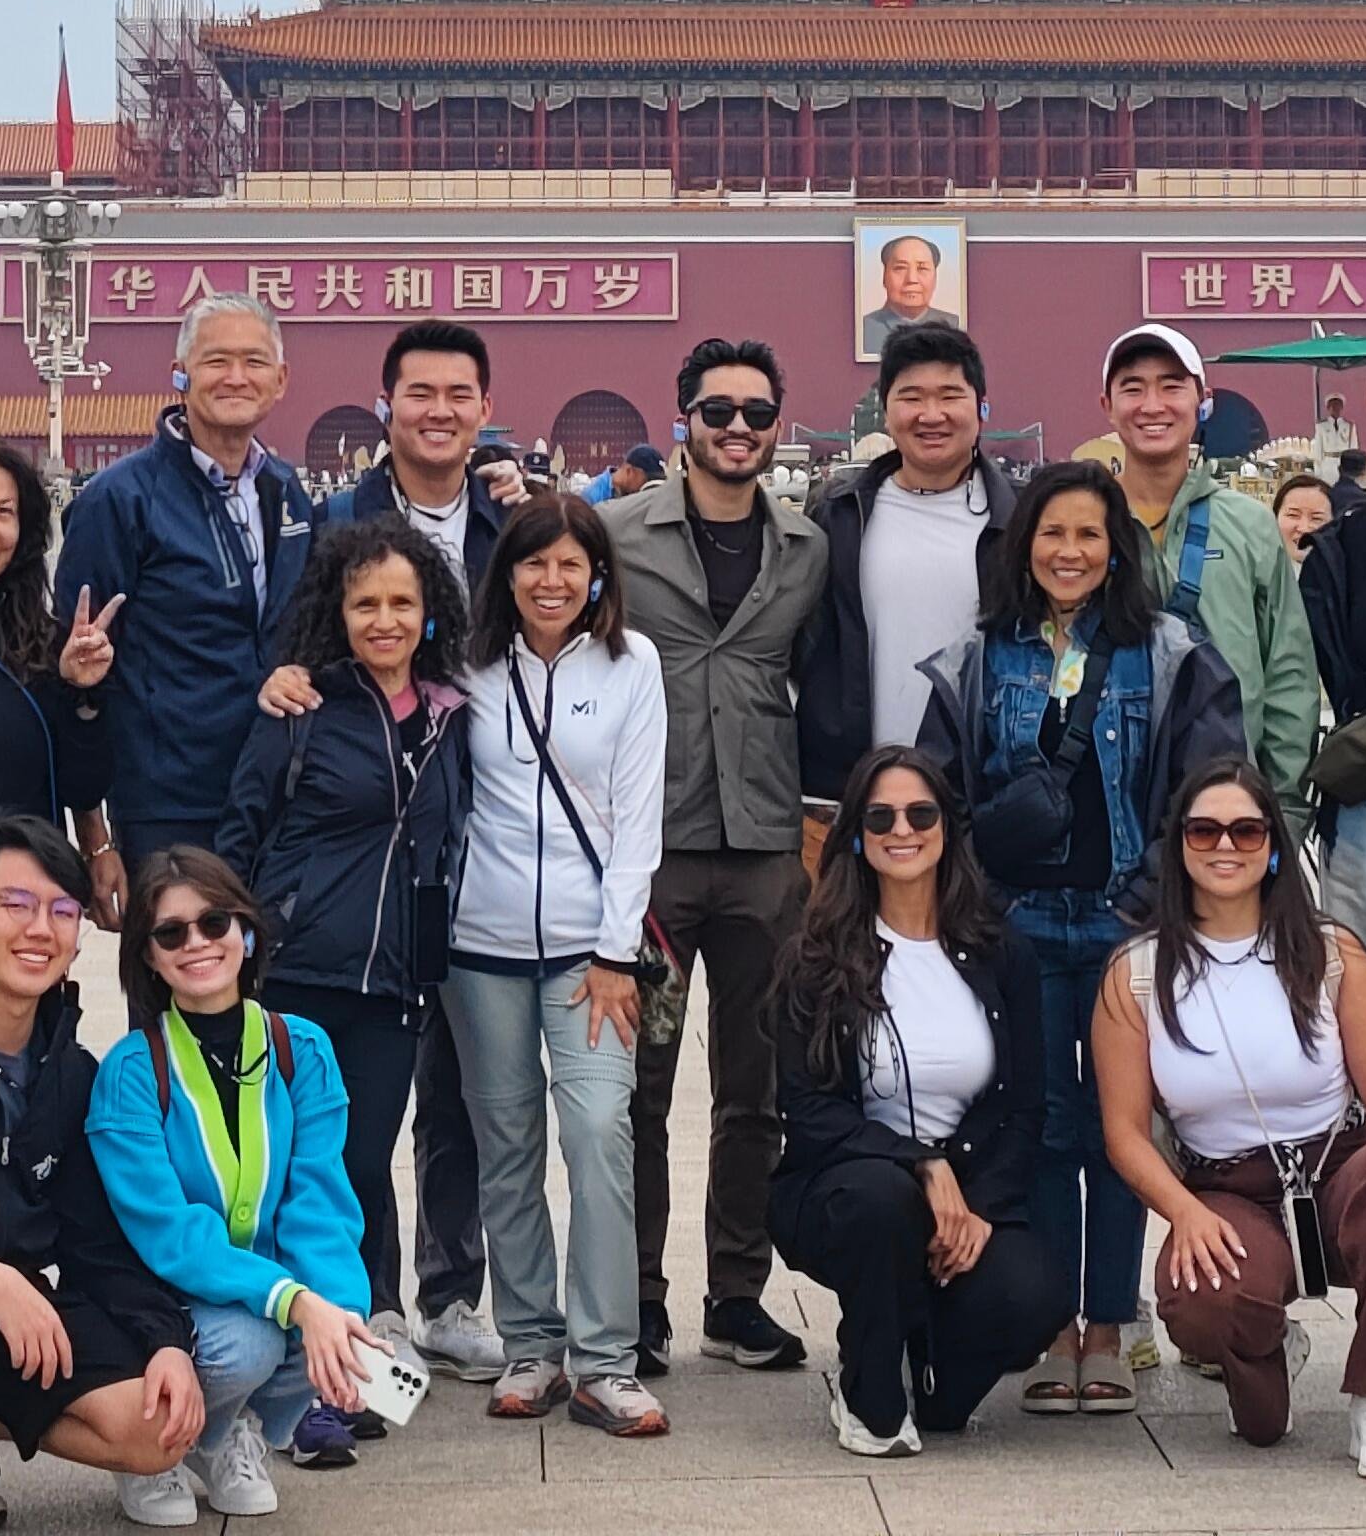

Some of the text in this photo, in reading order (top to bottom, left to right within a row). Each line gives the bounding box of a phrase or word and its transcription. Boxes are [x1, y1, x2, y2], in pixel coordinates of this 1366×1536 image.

[40, 265, 640, 310] 华人民共和国万岁
